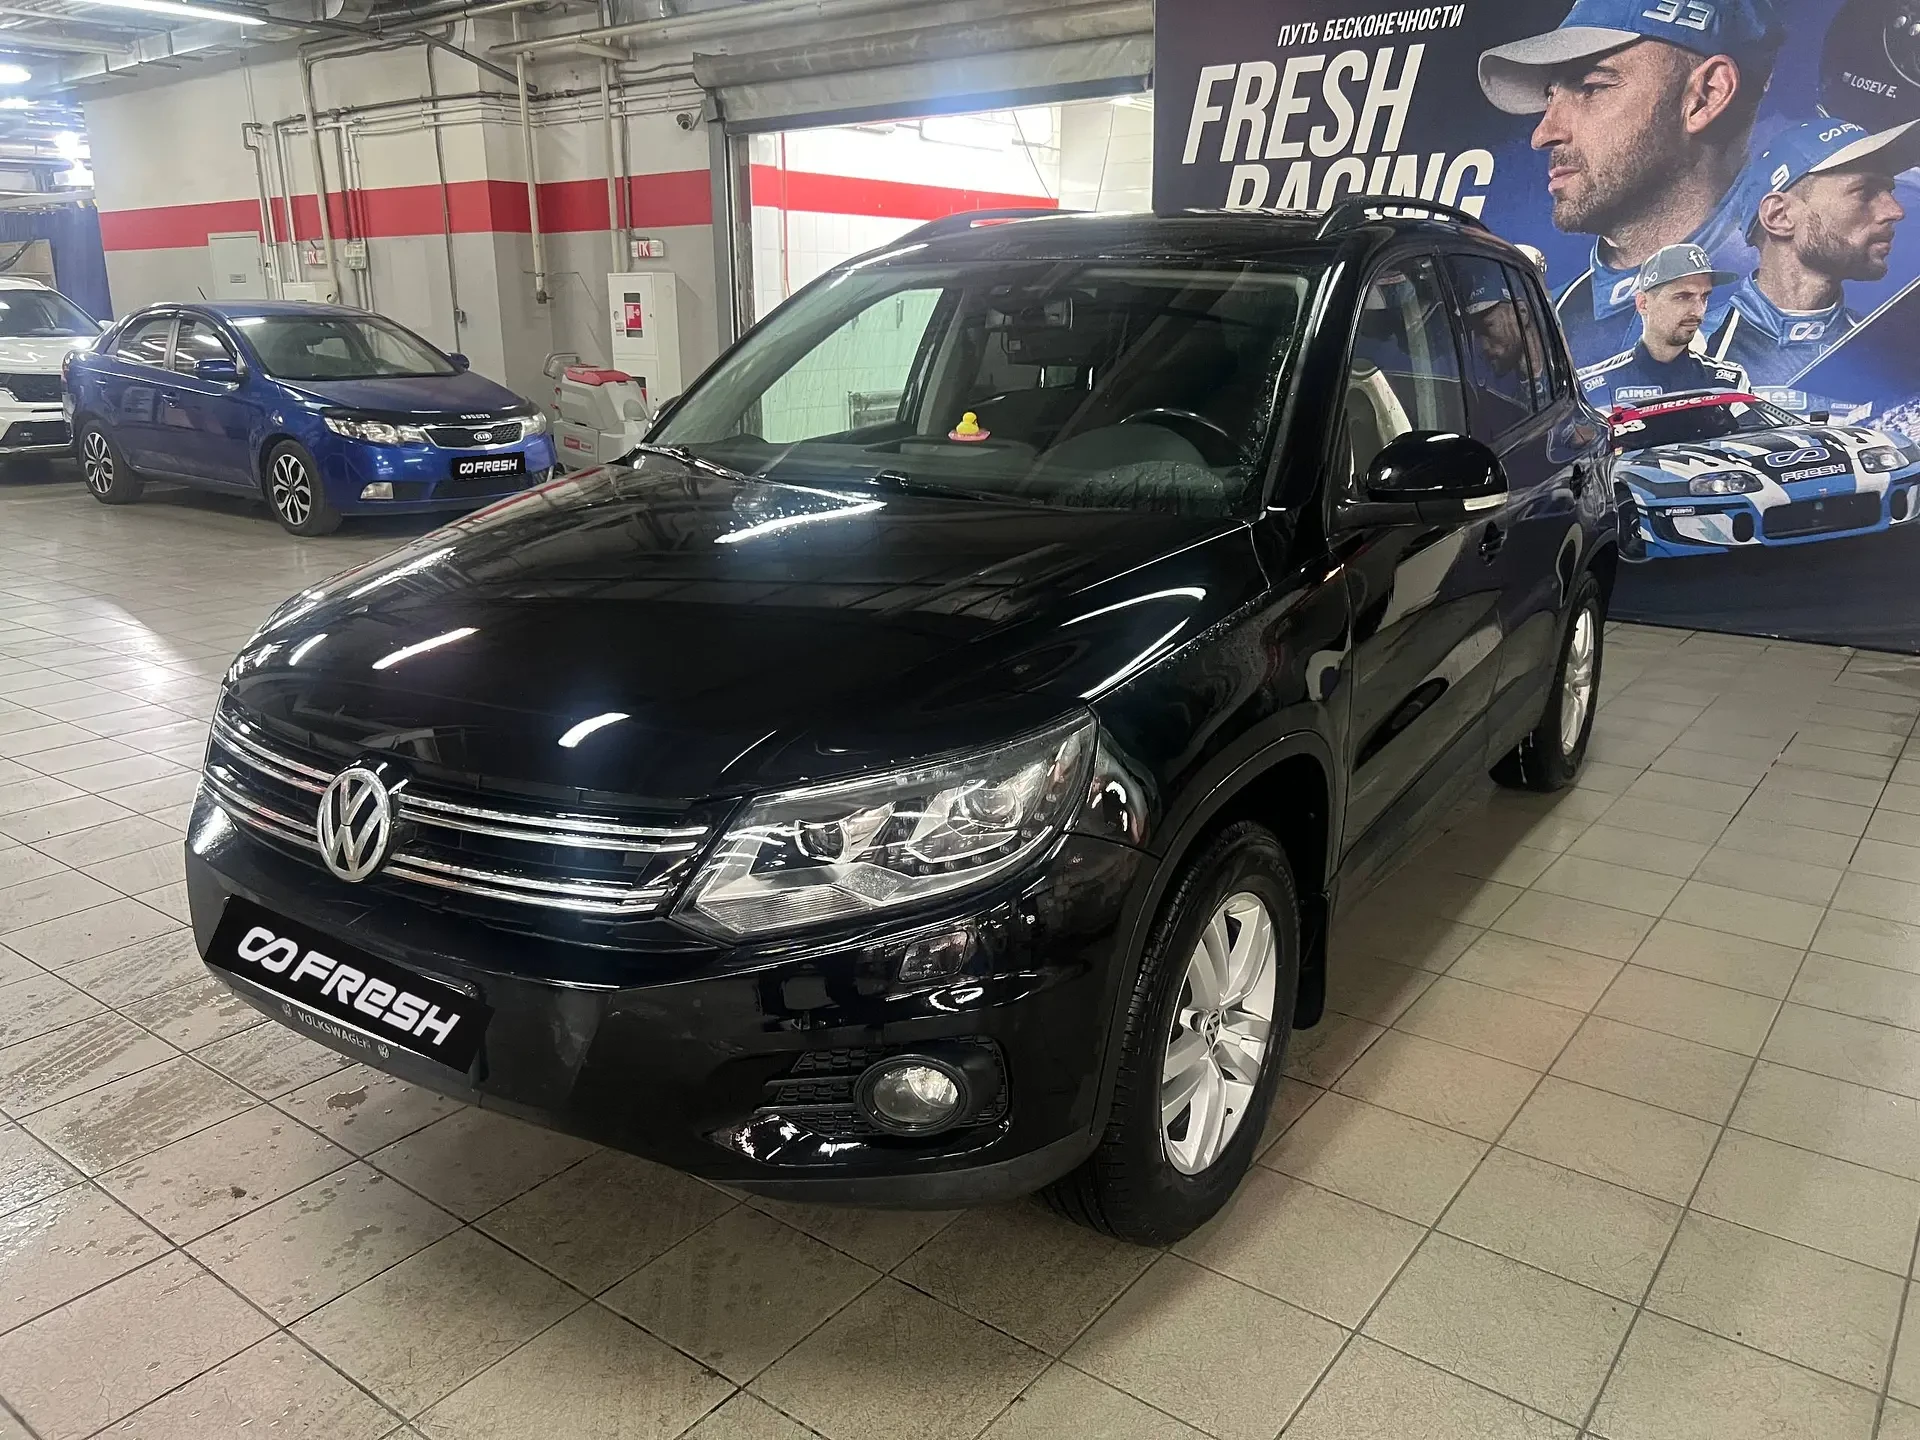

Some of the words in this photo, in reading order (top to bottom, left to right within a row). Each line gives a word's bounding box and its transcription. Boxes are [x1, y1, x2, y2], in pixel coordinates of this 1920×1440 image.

[1277, 22, 1319, 47] ПУТЬ
[1322, 4, 1466, 42] БЕСКОНЕЧНОСТИ
[1182, 43, 1426, 164] FRESH
[1850, 75, 1887, 94] LOSEV
[1885, 85, 1898, 99] E.
[297, 1010, 372, 1051] VOLKSWAGEN
